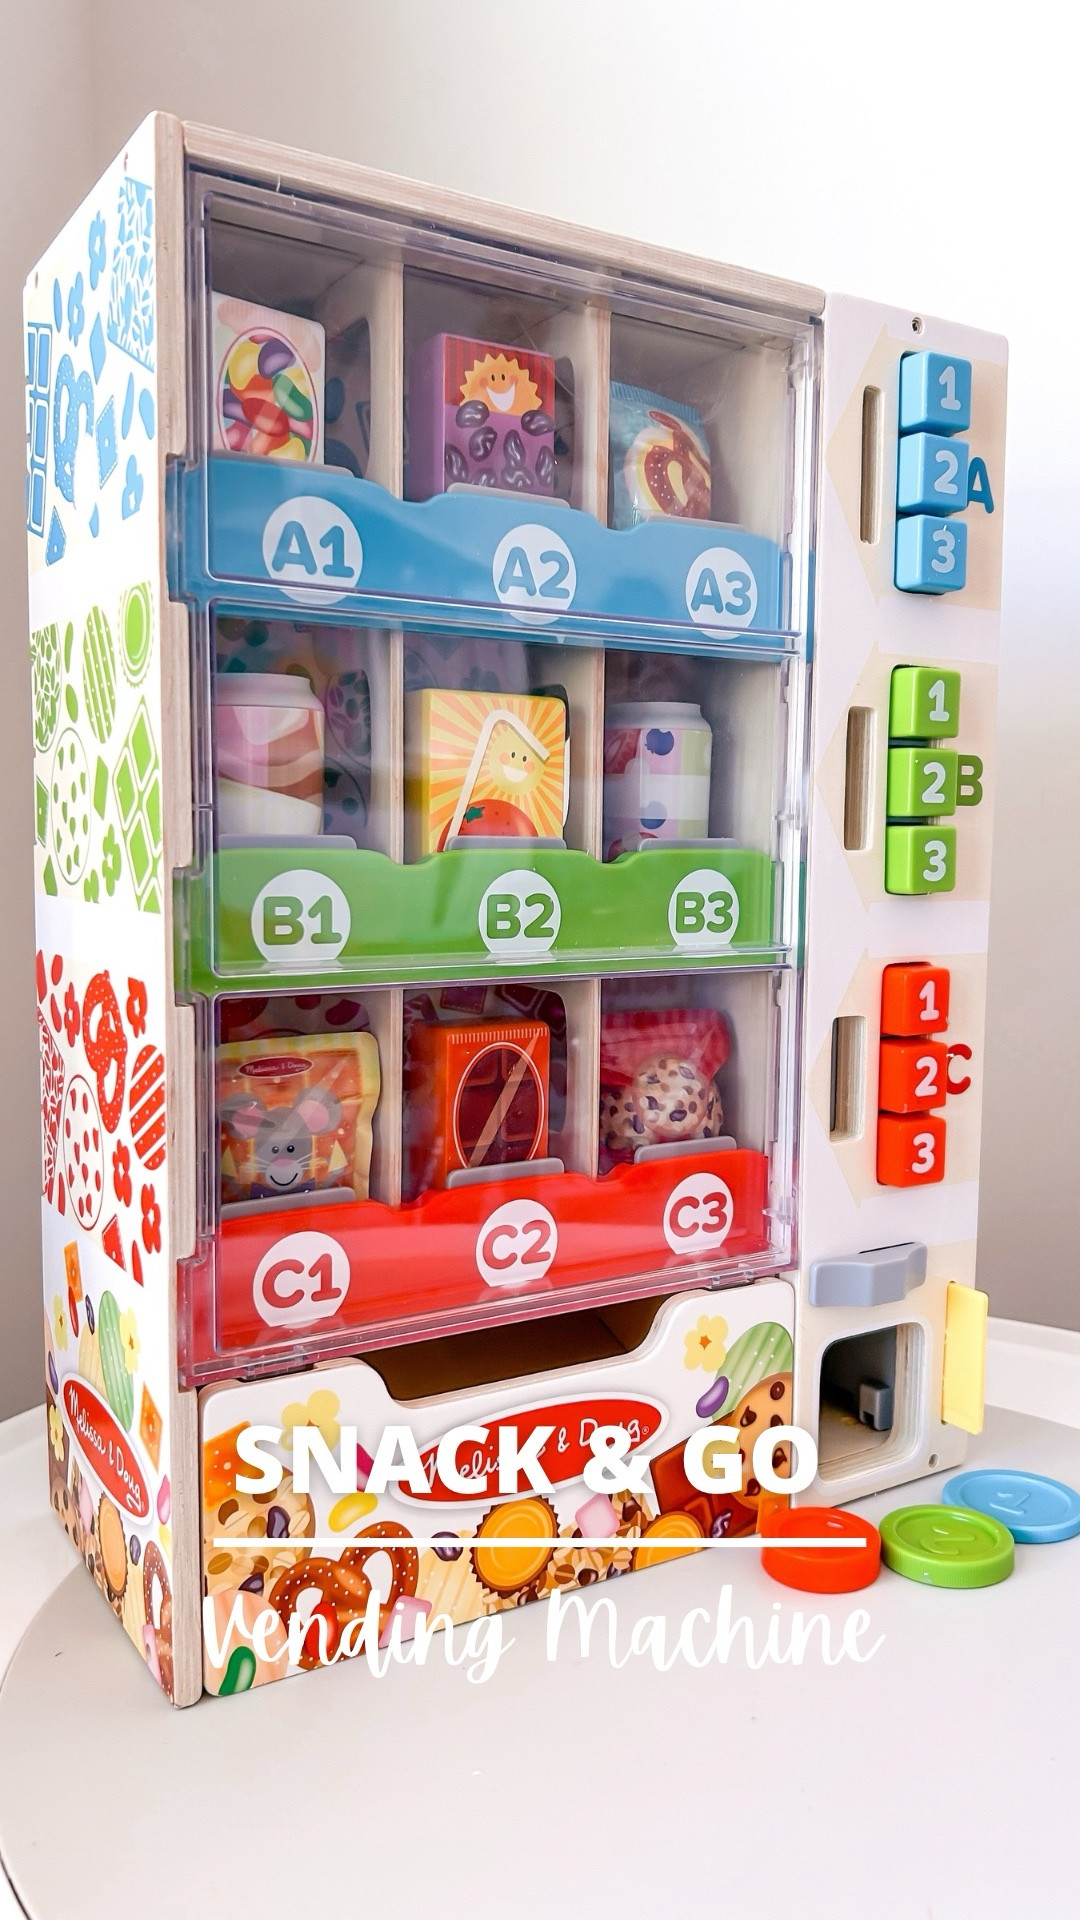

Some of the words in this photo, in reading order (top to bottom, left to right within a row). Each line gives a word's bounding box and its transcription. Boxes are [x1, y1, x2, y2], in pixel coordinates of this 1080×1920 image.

[939, 366, 960, 410] 1
[934, 450, 958, 494] 2
[967, 456, 994, 514] A
[271, 521, 355, 579] A1
[931, 530, 956, 574] 3
[498, 547, 572, 600] A2
[690, 569, 752, 616] A3
[928, 680, 949, 722] 1
[922, 762, 945, 803] 2
[956, 755, 983, 806] B
[922, 840, 947, 881] 3
[262, 895, 343, 945] B1
[486, 893, 555, 939] B2
[675, 891, 733, 933] B3
[919, 980, 939, 1021] 1
[915, 1056, 938, 1097] 2
[946, 1043, 972, 1095] C
[912, 1132, 935, 1174] 3
[668, 1192, 728, 1237] C3
[482, 1219, 551, 1270] C2
[261, 1253, 342, 1309] C1
[69, 1384, 106, 1456] Melissa
